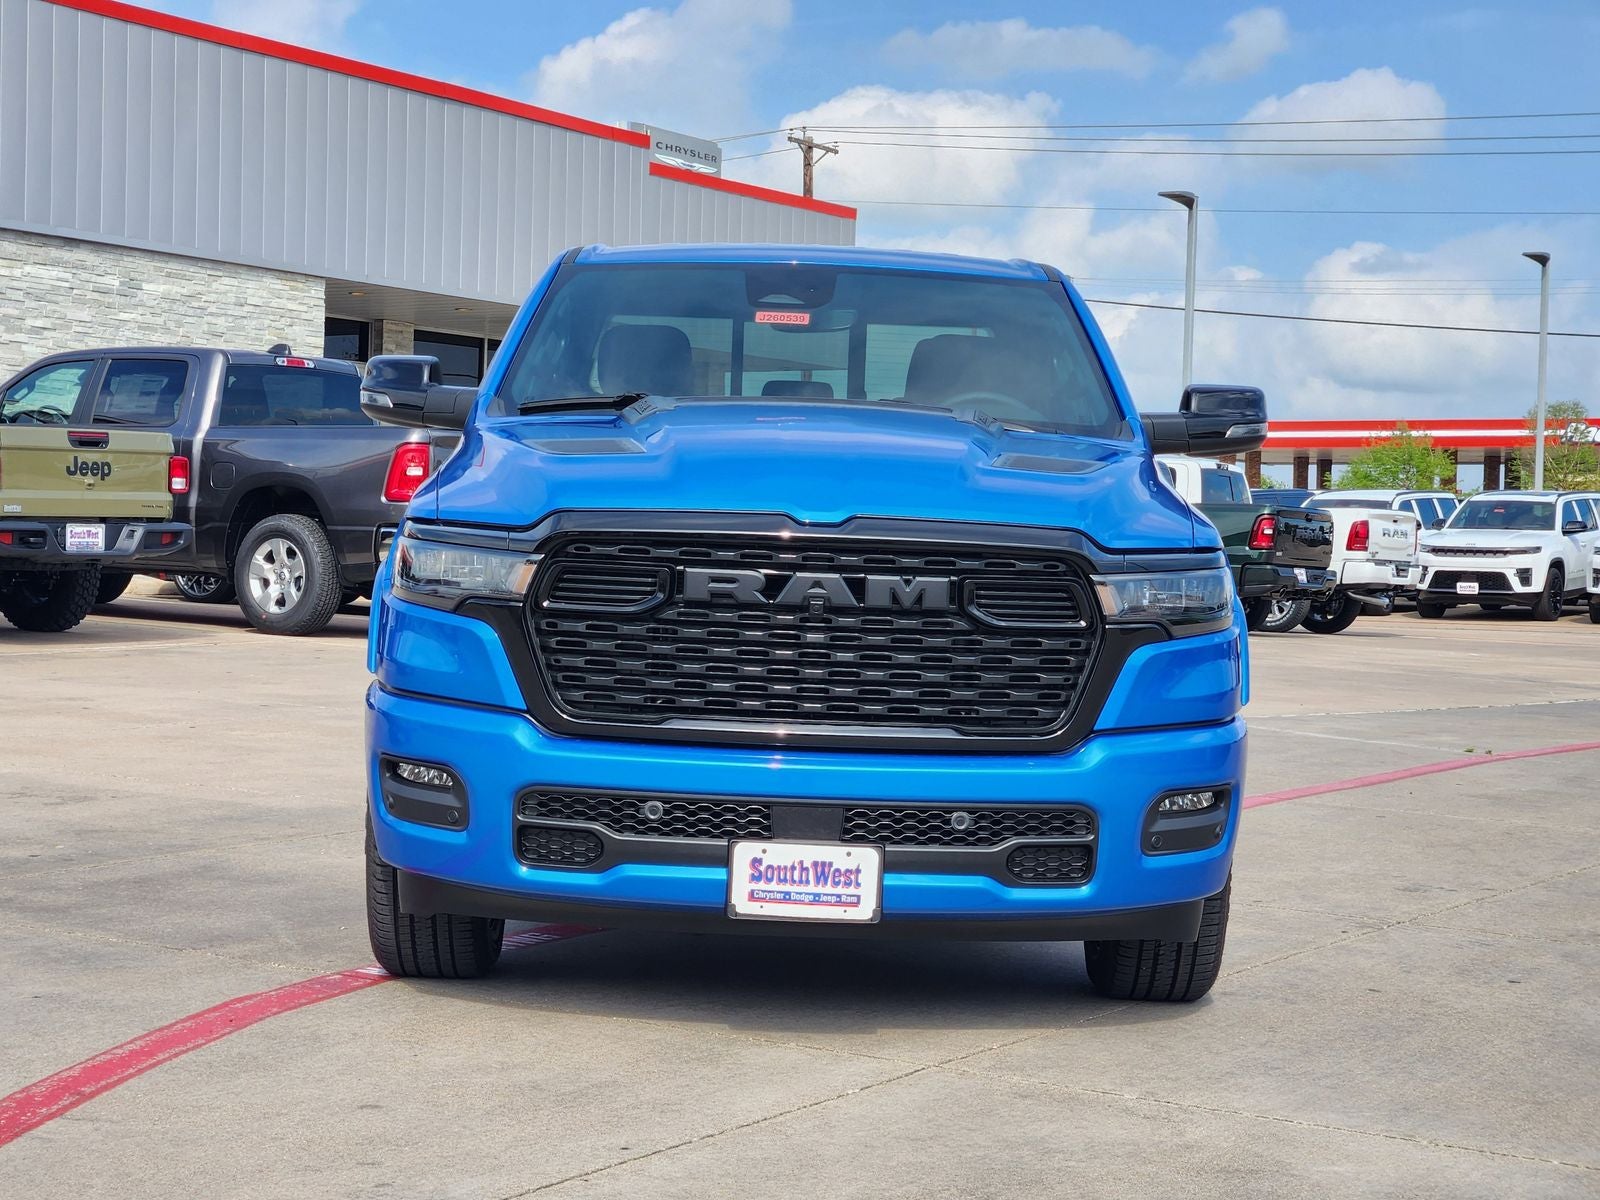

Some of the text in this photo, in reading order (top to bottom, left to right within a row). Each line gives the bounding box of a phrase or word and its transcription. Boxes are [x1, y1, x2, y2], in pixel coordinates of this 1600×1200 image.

[655, 141, 718, 163] CHRYSLER
[760, 314, 805, 323] J260539
[66, 456, 112, 481] Jeep
[1382, 528, 1408, 539] RAM
[683, 567, 950, 609] RAM
[753, 890, 857, 904] Chrysler Dodge Jeep Ram
